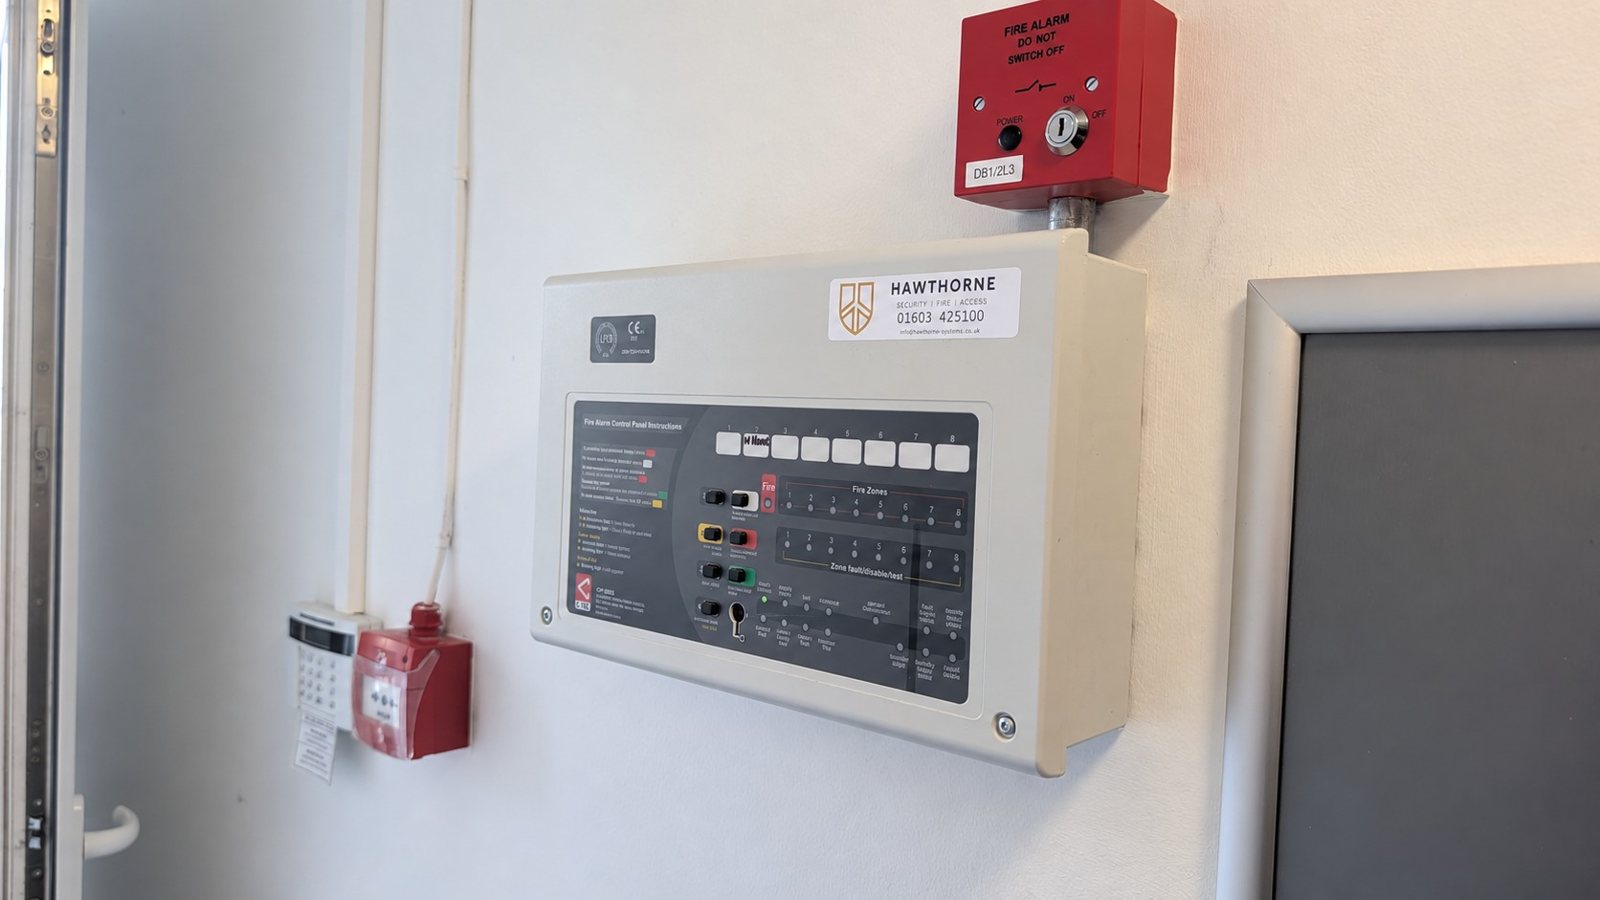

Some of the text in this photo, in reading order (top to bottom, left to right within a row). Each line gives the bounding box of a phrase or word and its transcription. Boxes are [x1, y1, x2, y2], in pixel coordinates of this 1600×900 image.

[1004, 13, 1070, 37] FIRE ALARM
[1018, 31, 1056, 48] DO NOT
[1008, 45, 1064, 64] SWITCH OFF
[1062, 95, 1075, 104] ON
[996, 114, 1024, 126] POWER
[1092, 109, 1107, 120] OFF
[974, 164, 1015, 180] DB1/2L3
[891, 276, 996, 296] HAWTHORNE
[896, 300, 928, 309] SECURITY
[897, 310, 985, 324] 01603 425100
[648, 422, 682, 430] Instructions
[762, 482, 775, 492] Fire
[867, 487, 888, 496] Zones
[831, 562, 847, 571] Zone
